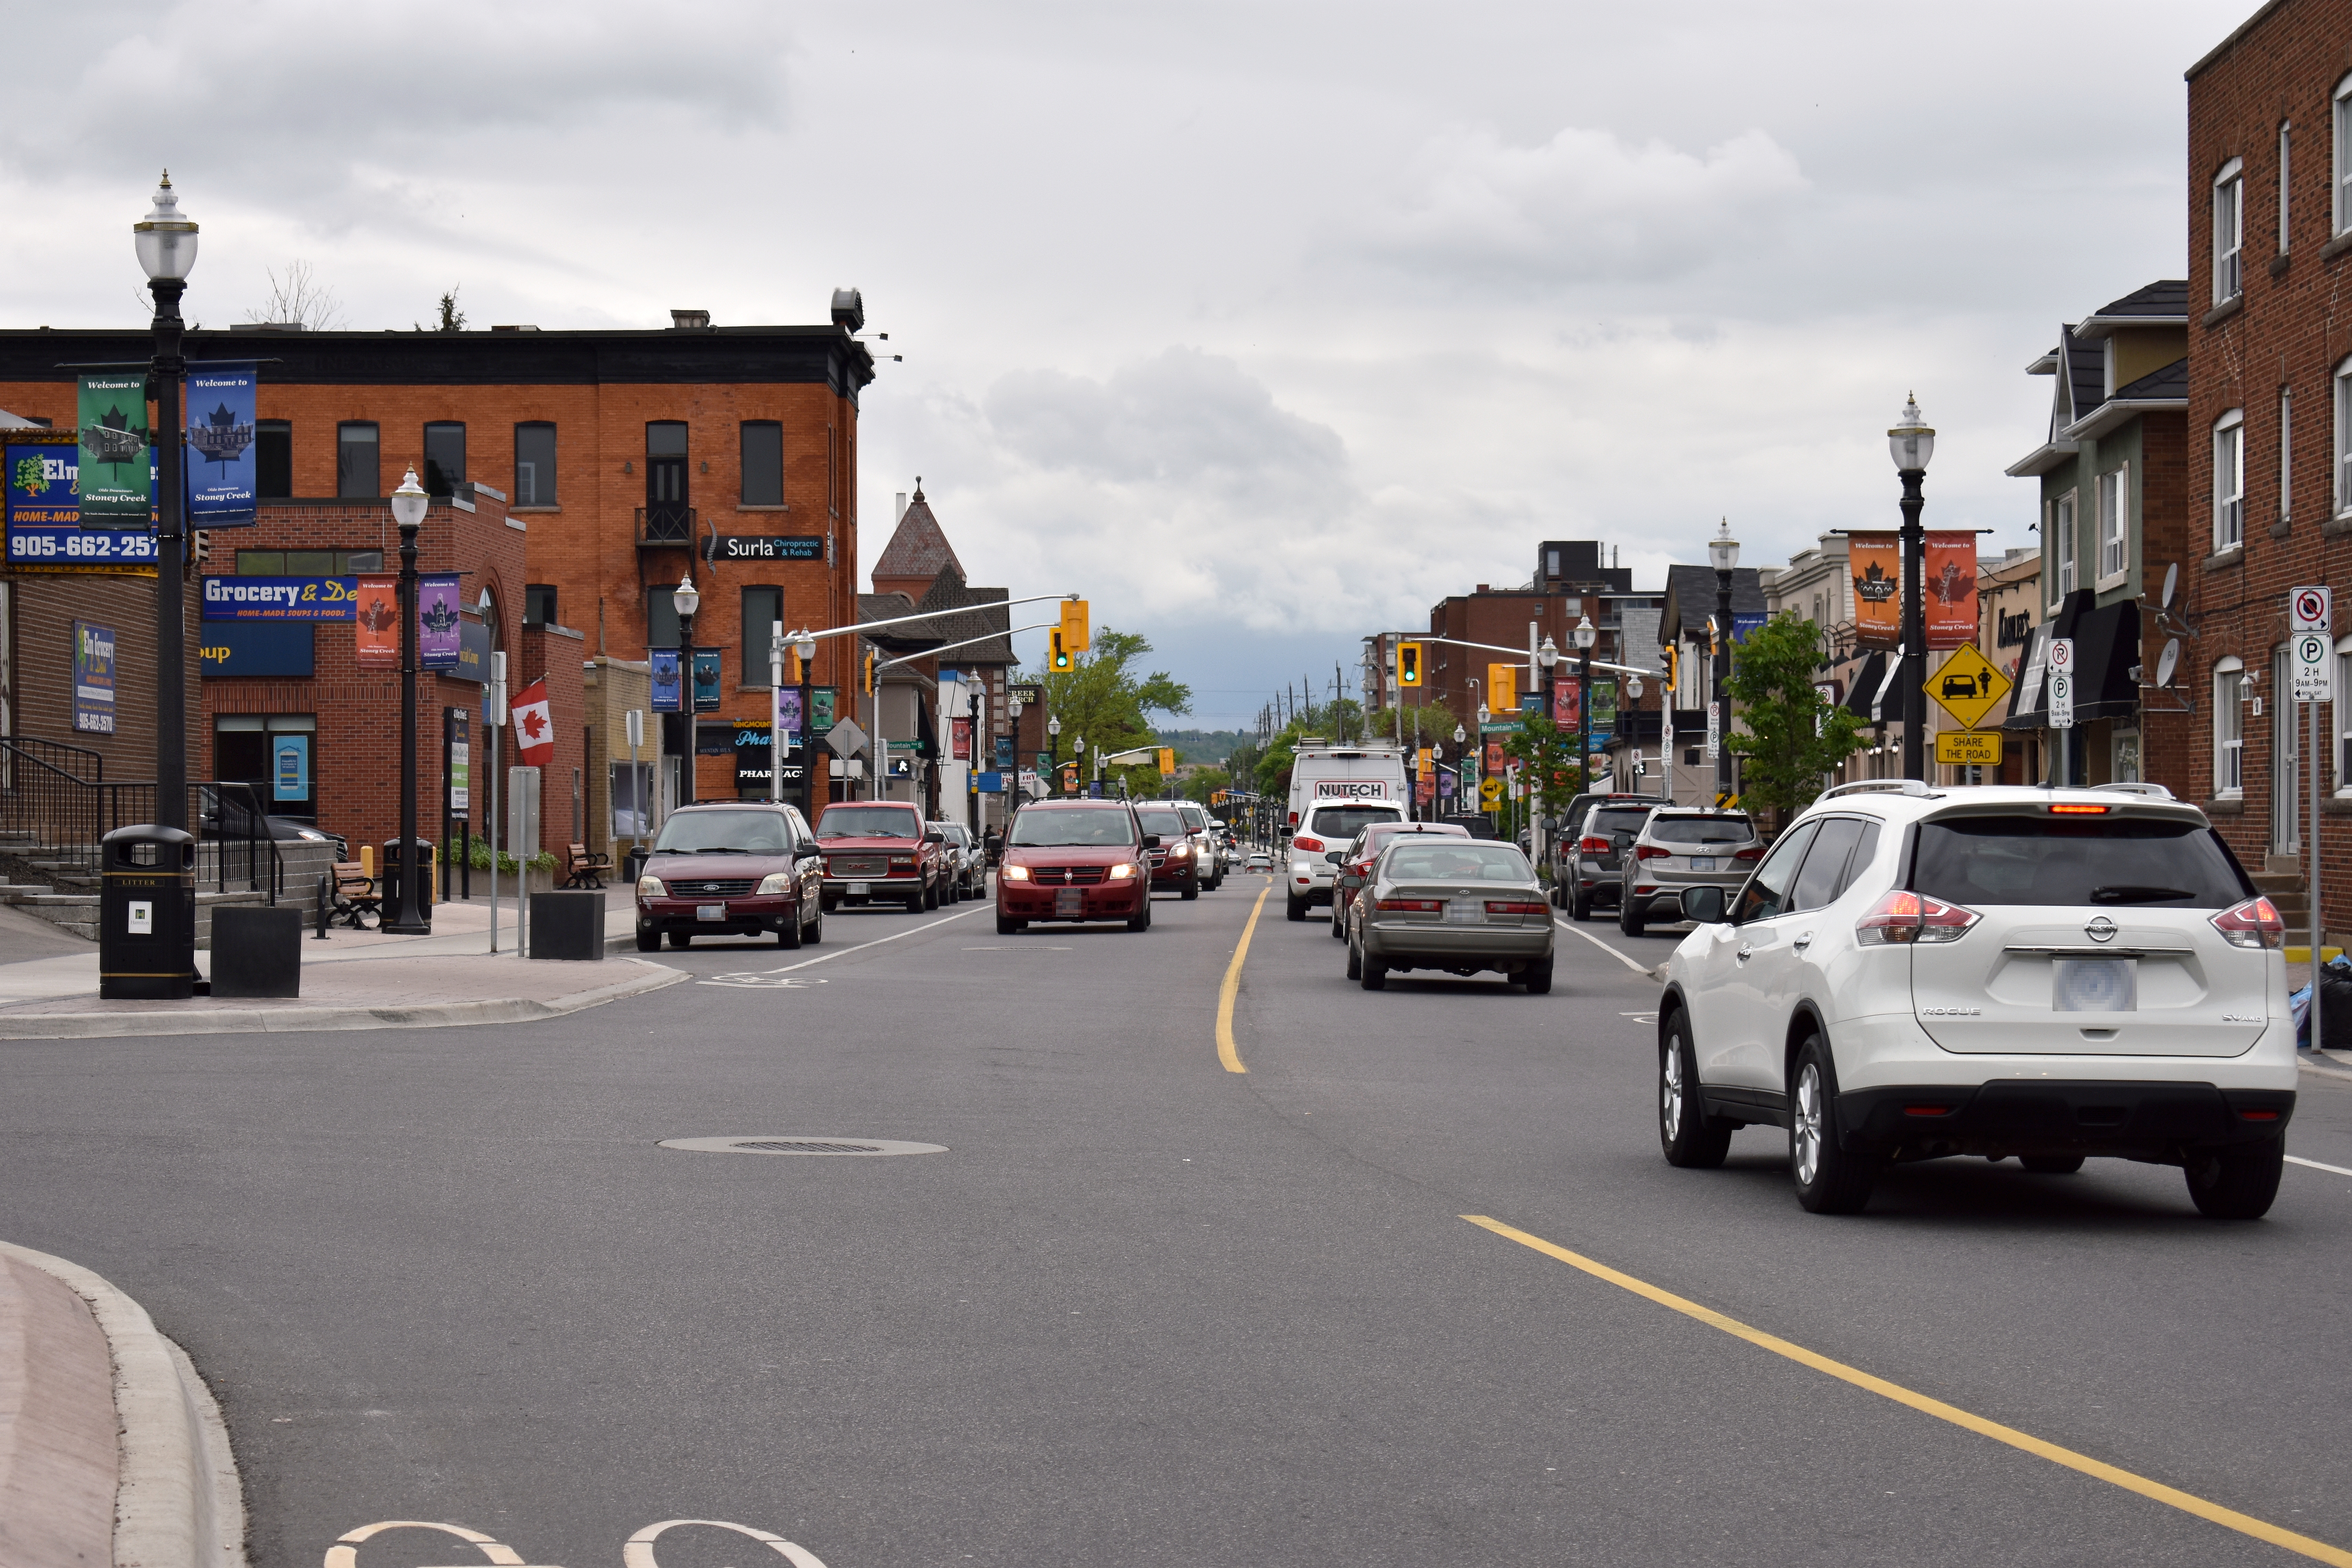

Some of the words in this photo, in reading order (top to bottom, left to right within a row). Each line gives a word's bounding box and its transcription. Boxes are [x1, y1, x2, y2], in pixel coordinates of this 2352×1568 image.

[85, 494, 118, 503] Stoney
[227, 491, 251, 499] Creek
[14, 512, 79, 522] HOME-MAD
[12, 536, 158, 556] 905-662-257
[728, 539, 774, 556] Surla
[774, 540, 818, 549] Chiropractic
[206, 580, 299, 606] Grocery
[301, 584, 317, 601] &
[321, 581, 357, 601] De
[84, 630, 94, 655] Elm
[95, 633, 113, 664] Grocery
[2307, 643, 2318, 659] P
[2304, 667, 2309, 676] 2
[2313, 668, 2319, 676] H
[2058, 682, 2064, 695] P
[2296, 679, 2328, 687] 9AM-9PM
[79, 713, 112, 732] 905-662-2570
[1954, 738, 1983, 747] SHARE
[1946, 750, 1962, 758] THE
[1966, 750, 1991, 759] ROAD
[1319, 784, 1381, 796] NUTECH
